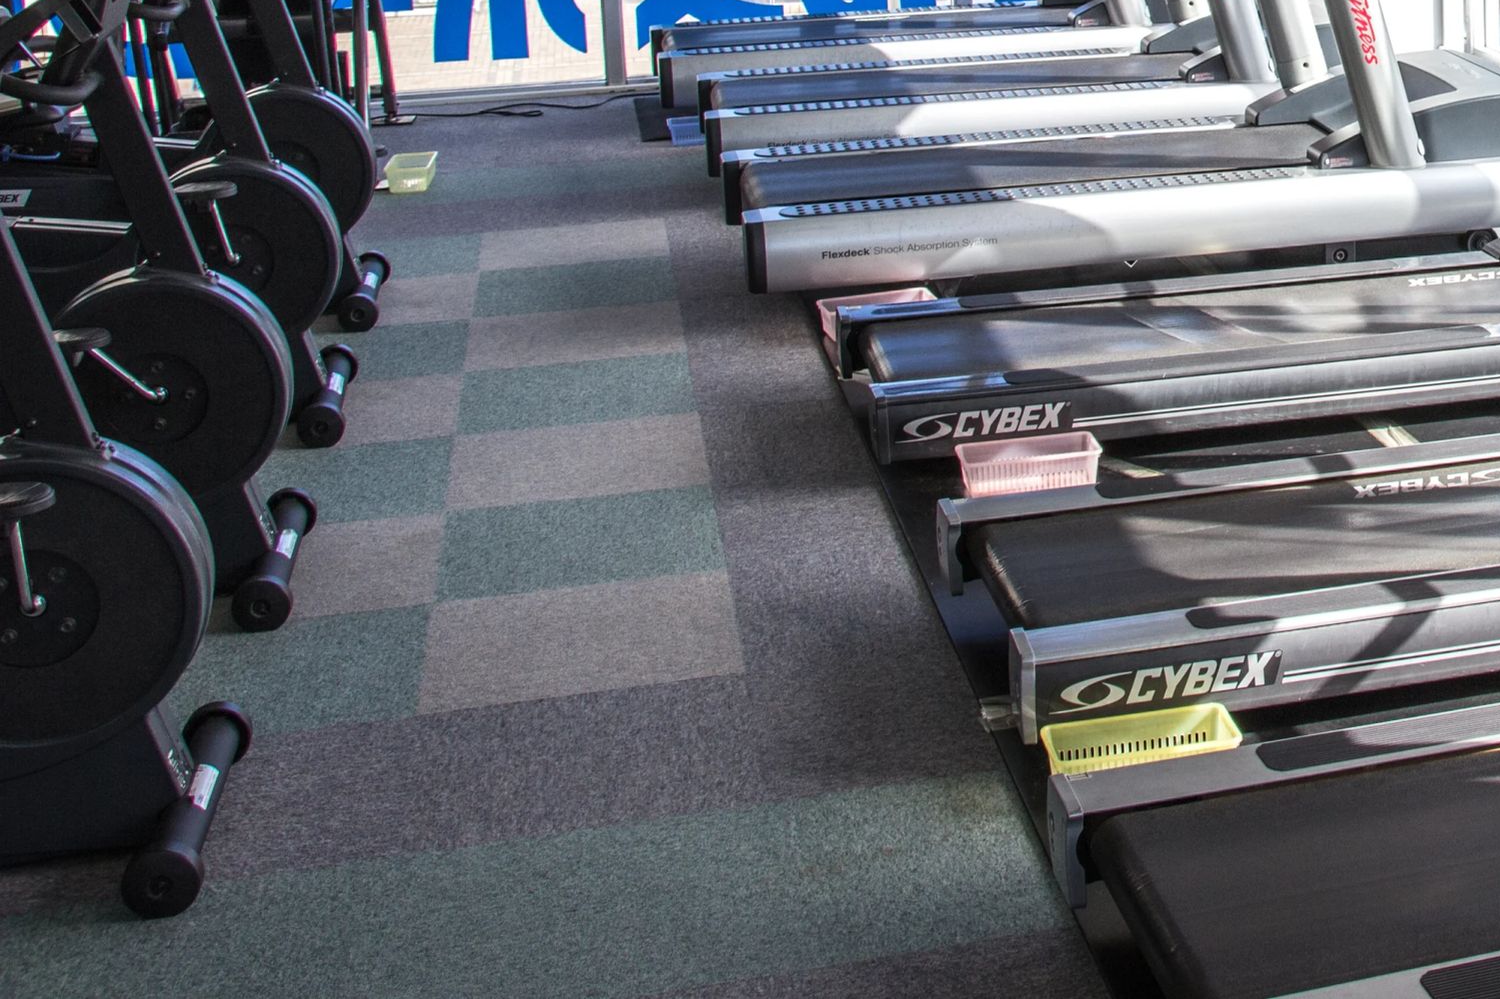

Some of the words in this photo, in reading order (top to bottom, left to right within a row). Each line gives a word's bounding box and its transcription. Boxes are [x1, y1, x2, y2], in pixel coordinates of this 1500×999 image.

[822, 248, 870, 260] Flexdeck
[873, 245, 904, 256] Shock
[907, 240, 960, 252] Absorption
[962, 237, 998, 249] Sytem
[1408, 271, 1495, 287] CYBEX
[953, 401, 1067, 438] CYBEX
[1353, 472, 1470, 498] CYBEX
[1126, 650, 1276, 705] CYBEX
